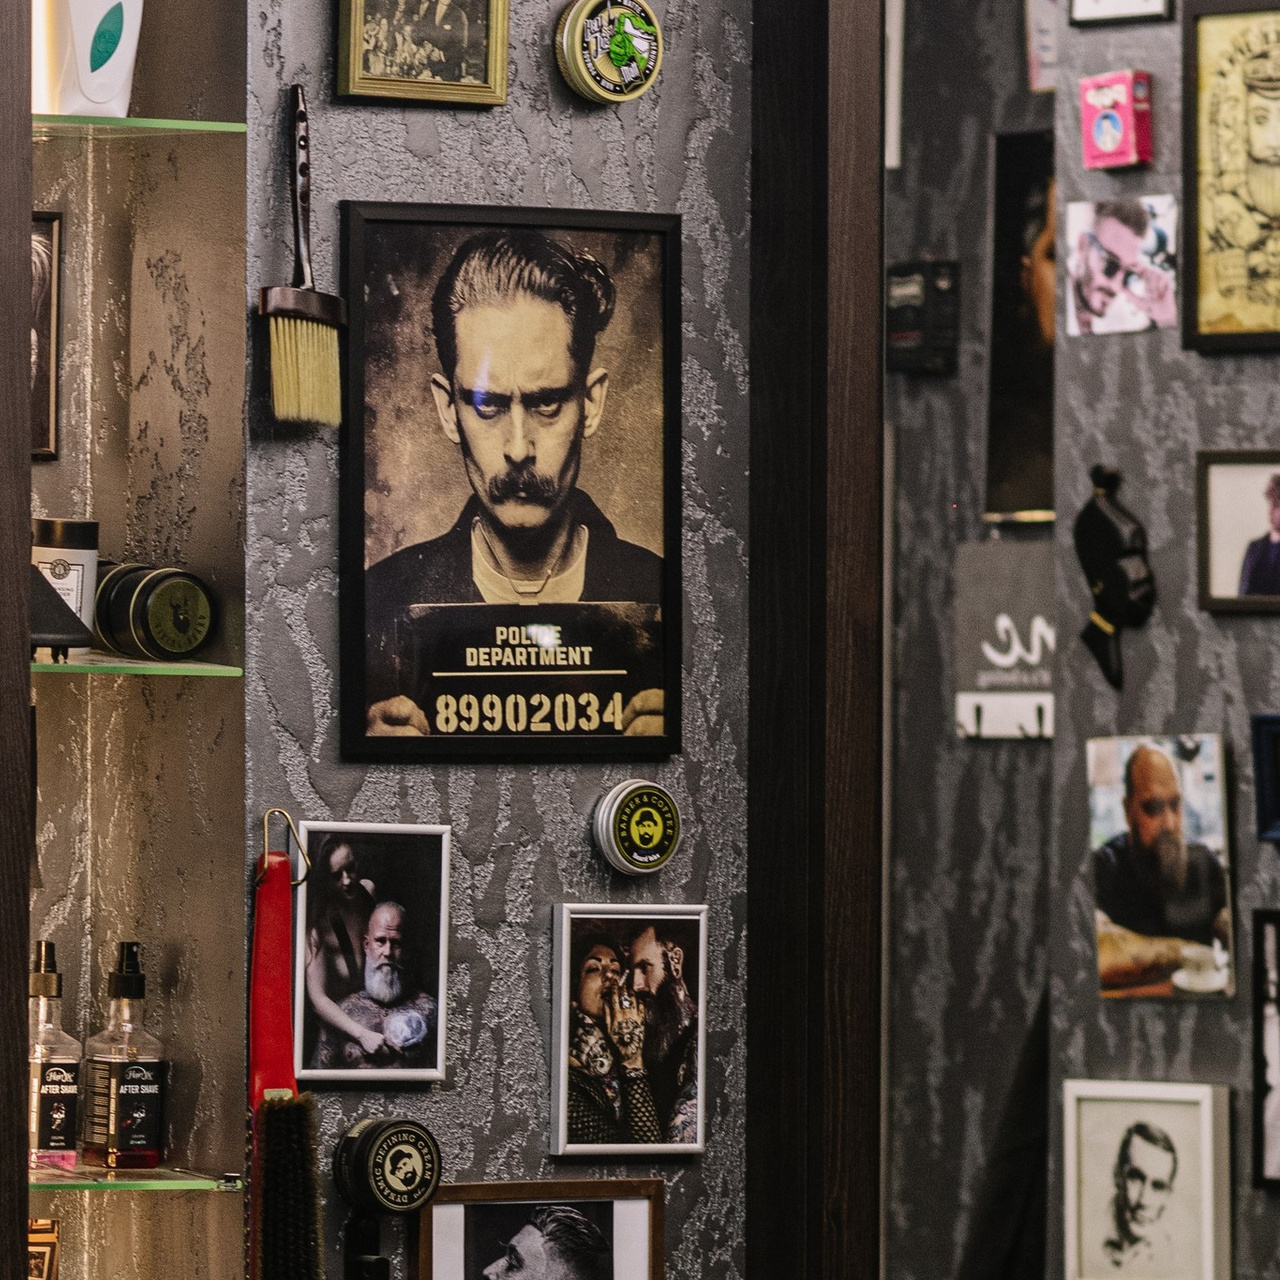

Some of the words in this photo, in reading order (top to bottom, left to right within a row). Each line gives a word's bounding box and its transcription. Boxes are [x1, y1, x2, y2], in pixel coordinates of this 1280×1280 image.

[465, 646, 593, 667] DEPARTMENT
[435, 691, 623, 734] 89902034
[620, 796, 641, 837] BARBER
[650, 796, 674, 836] COFFEE
[40, 1084, 60, 1095] AFTER
[119, 1084, 140, 1095] AFTER
[375, 1132, 416, 1163] DEFINING
[417, 1140, 433, 1180] CREAM
[374, 1167, 409, 1203] DYNAMIC
